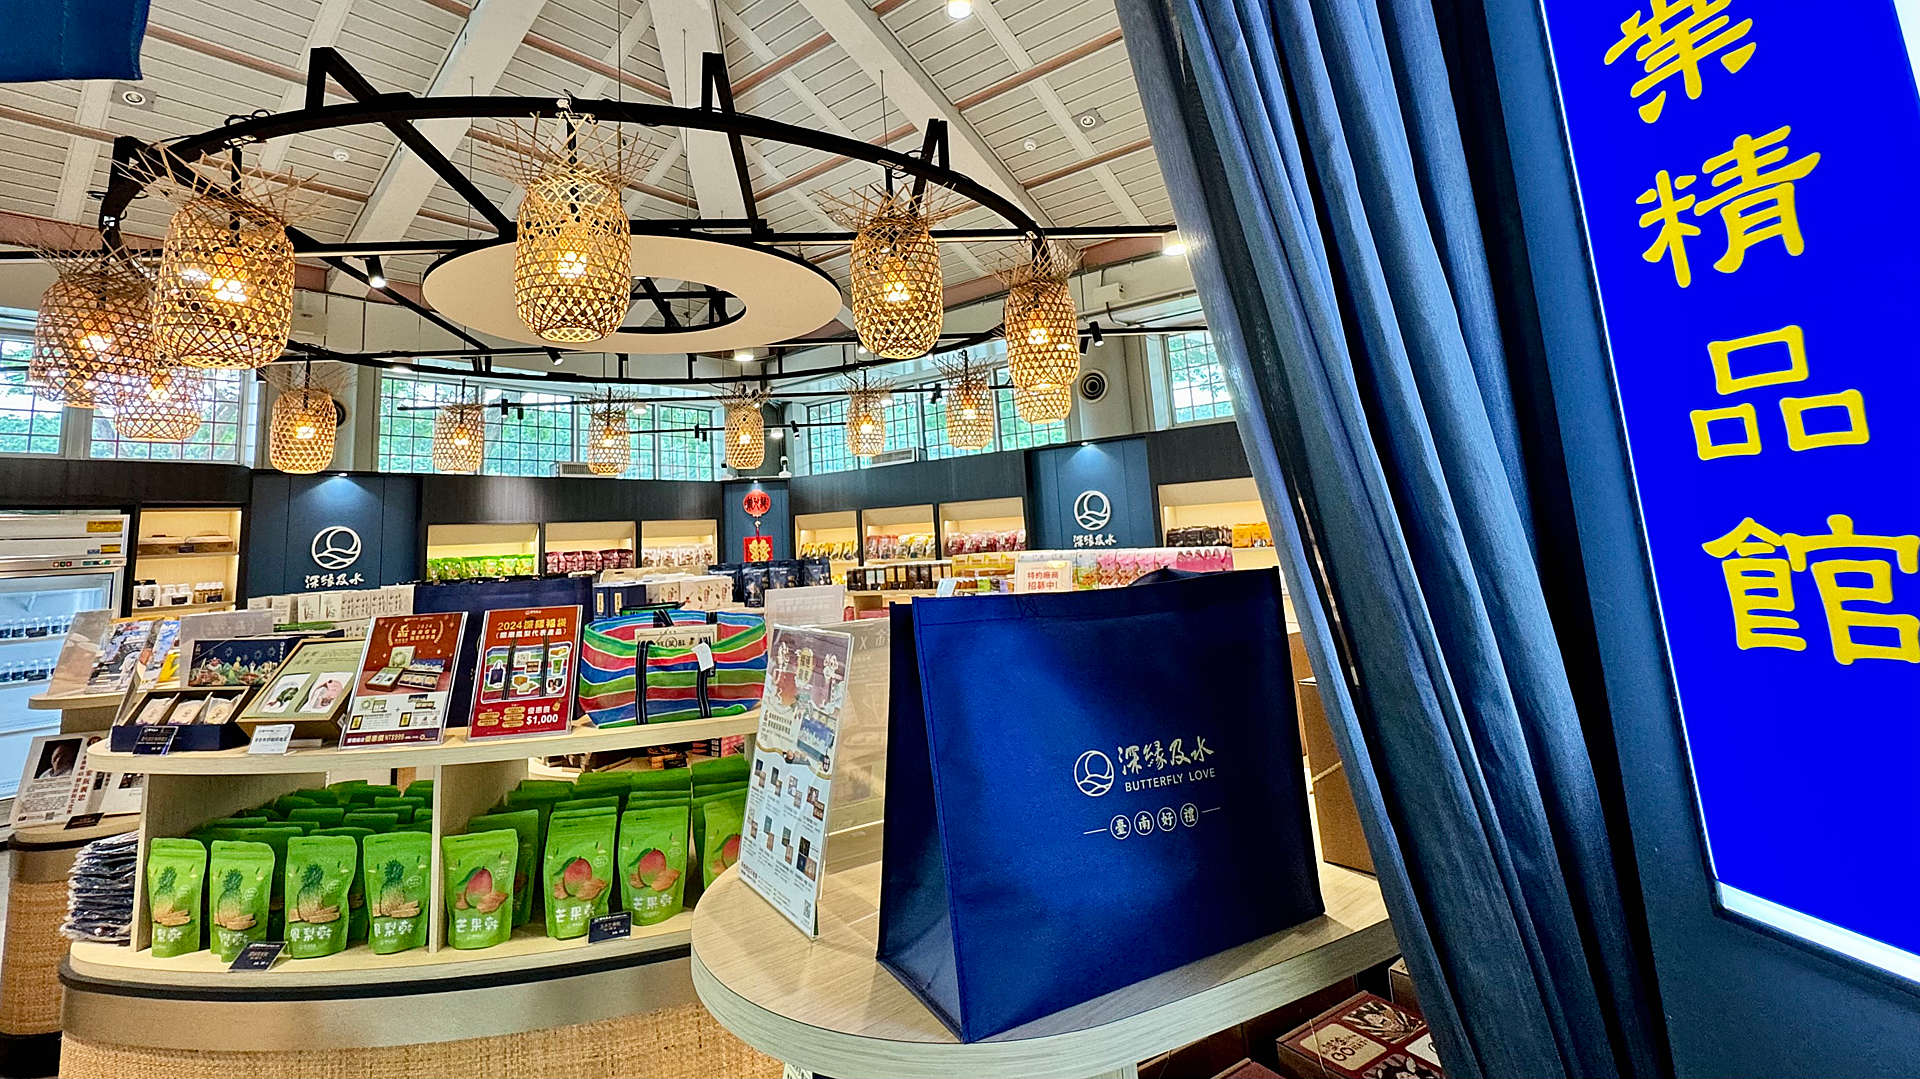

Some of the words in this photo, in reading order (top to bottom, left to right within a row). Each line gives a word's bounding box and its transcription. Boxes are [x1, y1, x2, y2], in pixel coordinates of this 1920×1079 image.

[1604, 0, 1920, 664] 業精品館
[1027, 571, 1059, 580] 特約廠商
[526, 714, 559, 726] $1,000
[1117, 735, 1215, 776] 深緣及水
[1124, 772, 1184, 793] BUTTERFLY
[1188, 767, 1216, 782] LOVE
